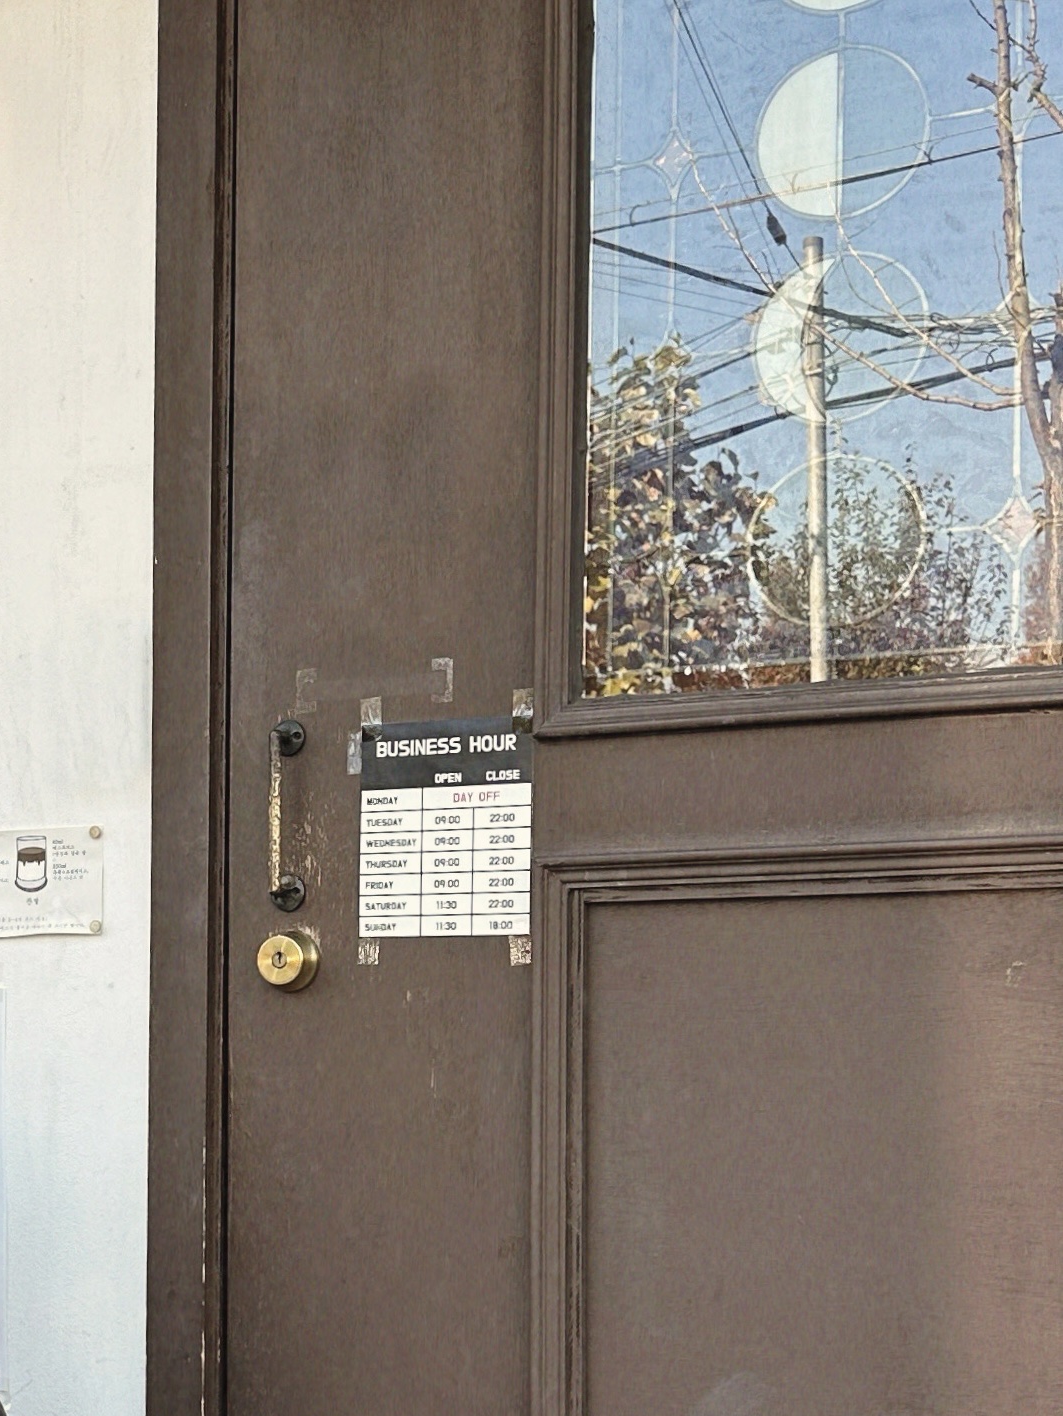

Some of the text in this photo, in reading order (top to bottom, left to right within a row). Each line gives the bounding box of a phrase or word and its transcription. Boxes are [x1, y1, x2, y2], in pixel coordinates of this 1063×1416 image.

[376, 733, 517, 758] BUSINESS HOUR
[434, 769, 521, 784] OPEN CLOSE
[367, 790, 500, 806] MONDAY DAY OFF
[367, 817, 403, 827] TUESDAY
[490, 813, 515, 823] 22:00
[366, 839, 417, 848] WEDNESDAY
[489, 835, 515, 844] 22:00
[366, 860, 408, 868] THURSDAY
[489, 856, 514, 866] 22:00
[365, 881, 393, 889] FRIDAY
[489, 878, 514, 887] 22:00
[365, 902, 406, 911] SATURDAY
[489, 899, 514, 908] 22:00
[365, 923, 396, 931] SUNDAY
[489, 921, 513, 929] 18:00
